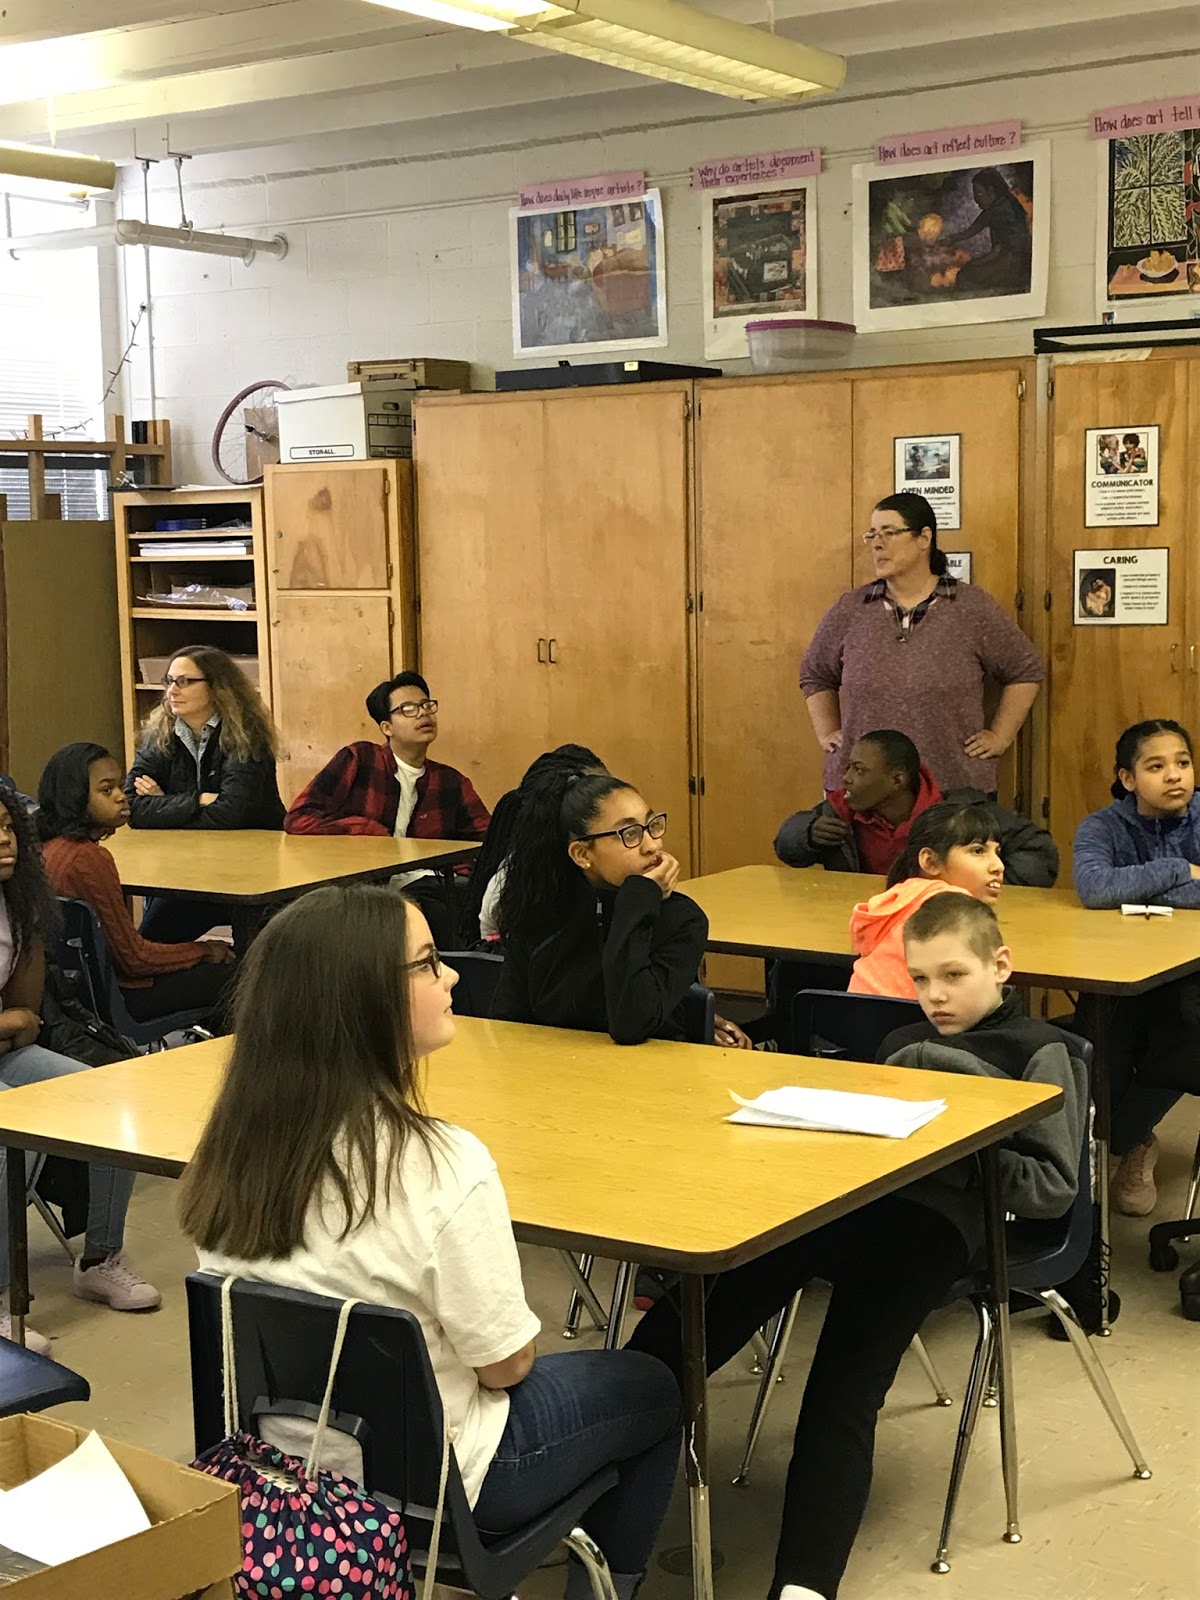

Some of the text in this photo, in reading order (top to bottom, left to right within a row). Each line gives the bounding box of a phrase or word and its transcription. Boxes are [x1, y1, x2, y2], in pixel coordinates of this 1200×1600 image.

[1094, 117, 1117, 132] How
[1120, 114, 1143, 129] does
[1145, 109, 1164, 124] art
[1171, 106, 1193, 121] tell
[878, 146, 897, 161] How
[900, 143, 921, 157] does
[923, 142, 938, 154] art
[942, 134, 971, 152] reflect
[973, 134, 1006, 149] culture
[719, 163, 730, 175] do
[732, 158, 765, 172] artists
[769, 150, 815, 168] document
[700, 177, 721, 188] their
[725, 169, 777, 185] experiences
[520, 193, 535, 207] How
[536, 191, 552, 205] does
[553, 188, 570, 205] daily
[607, 181, 635, 195] artists
[924, 485, 955, 495] MINDED
[1091, 479, 1154, 488] COMMUNICATOR
[1103, 555, 1139, 565] CARING
